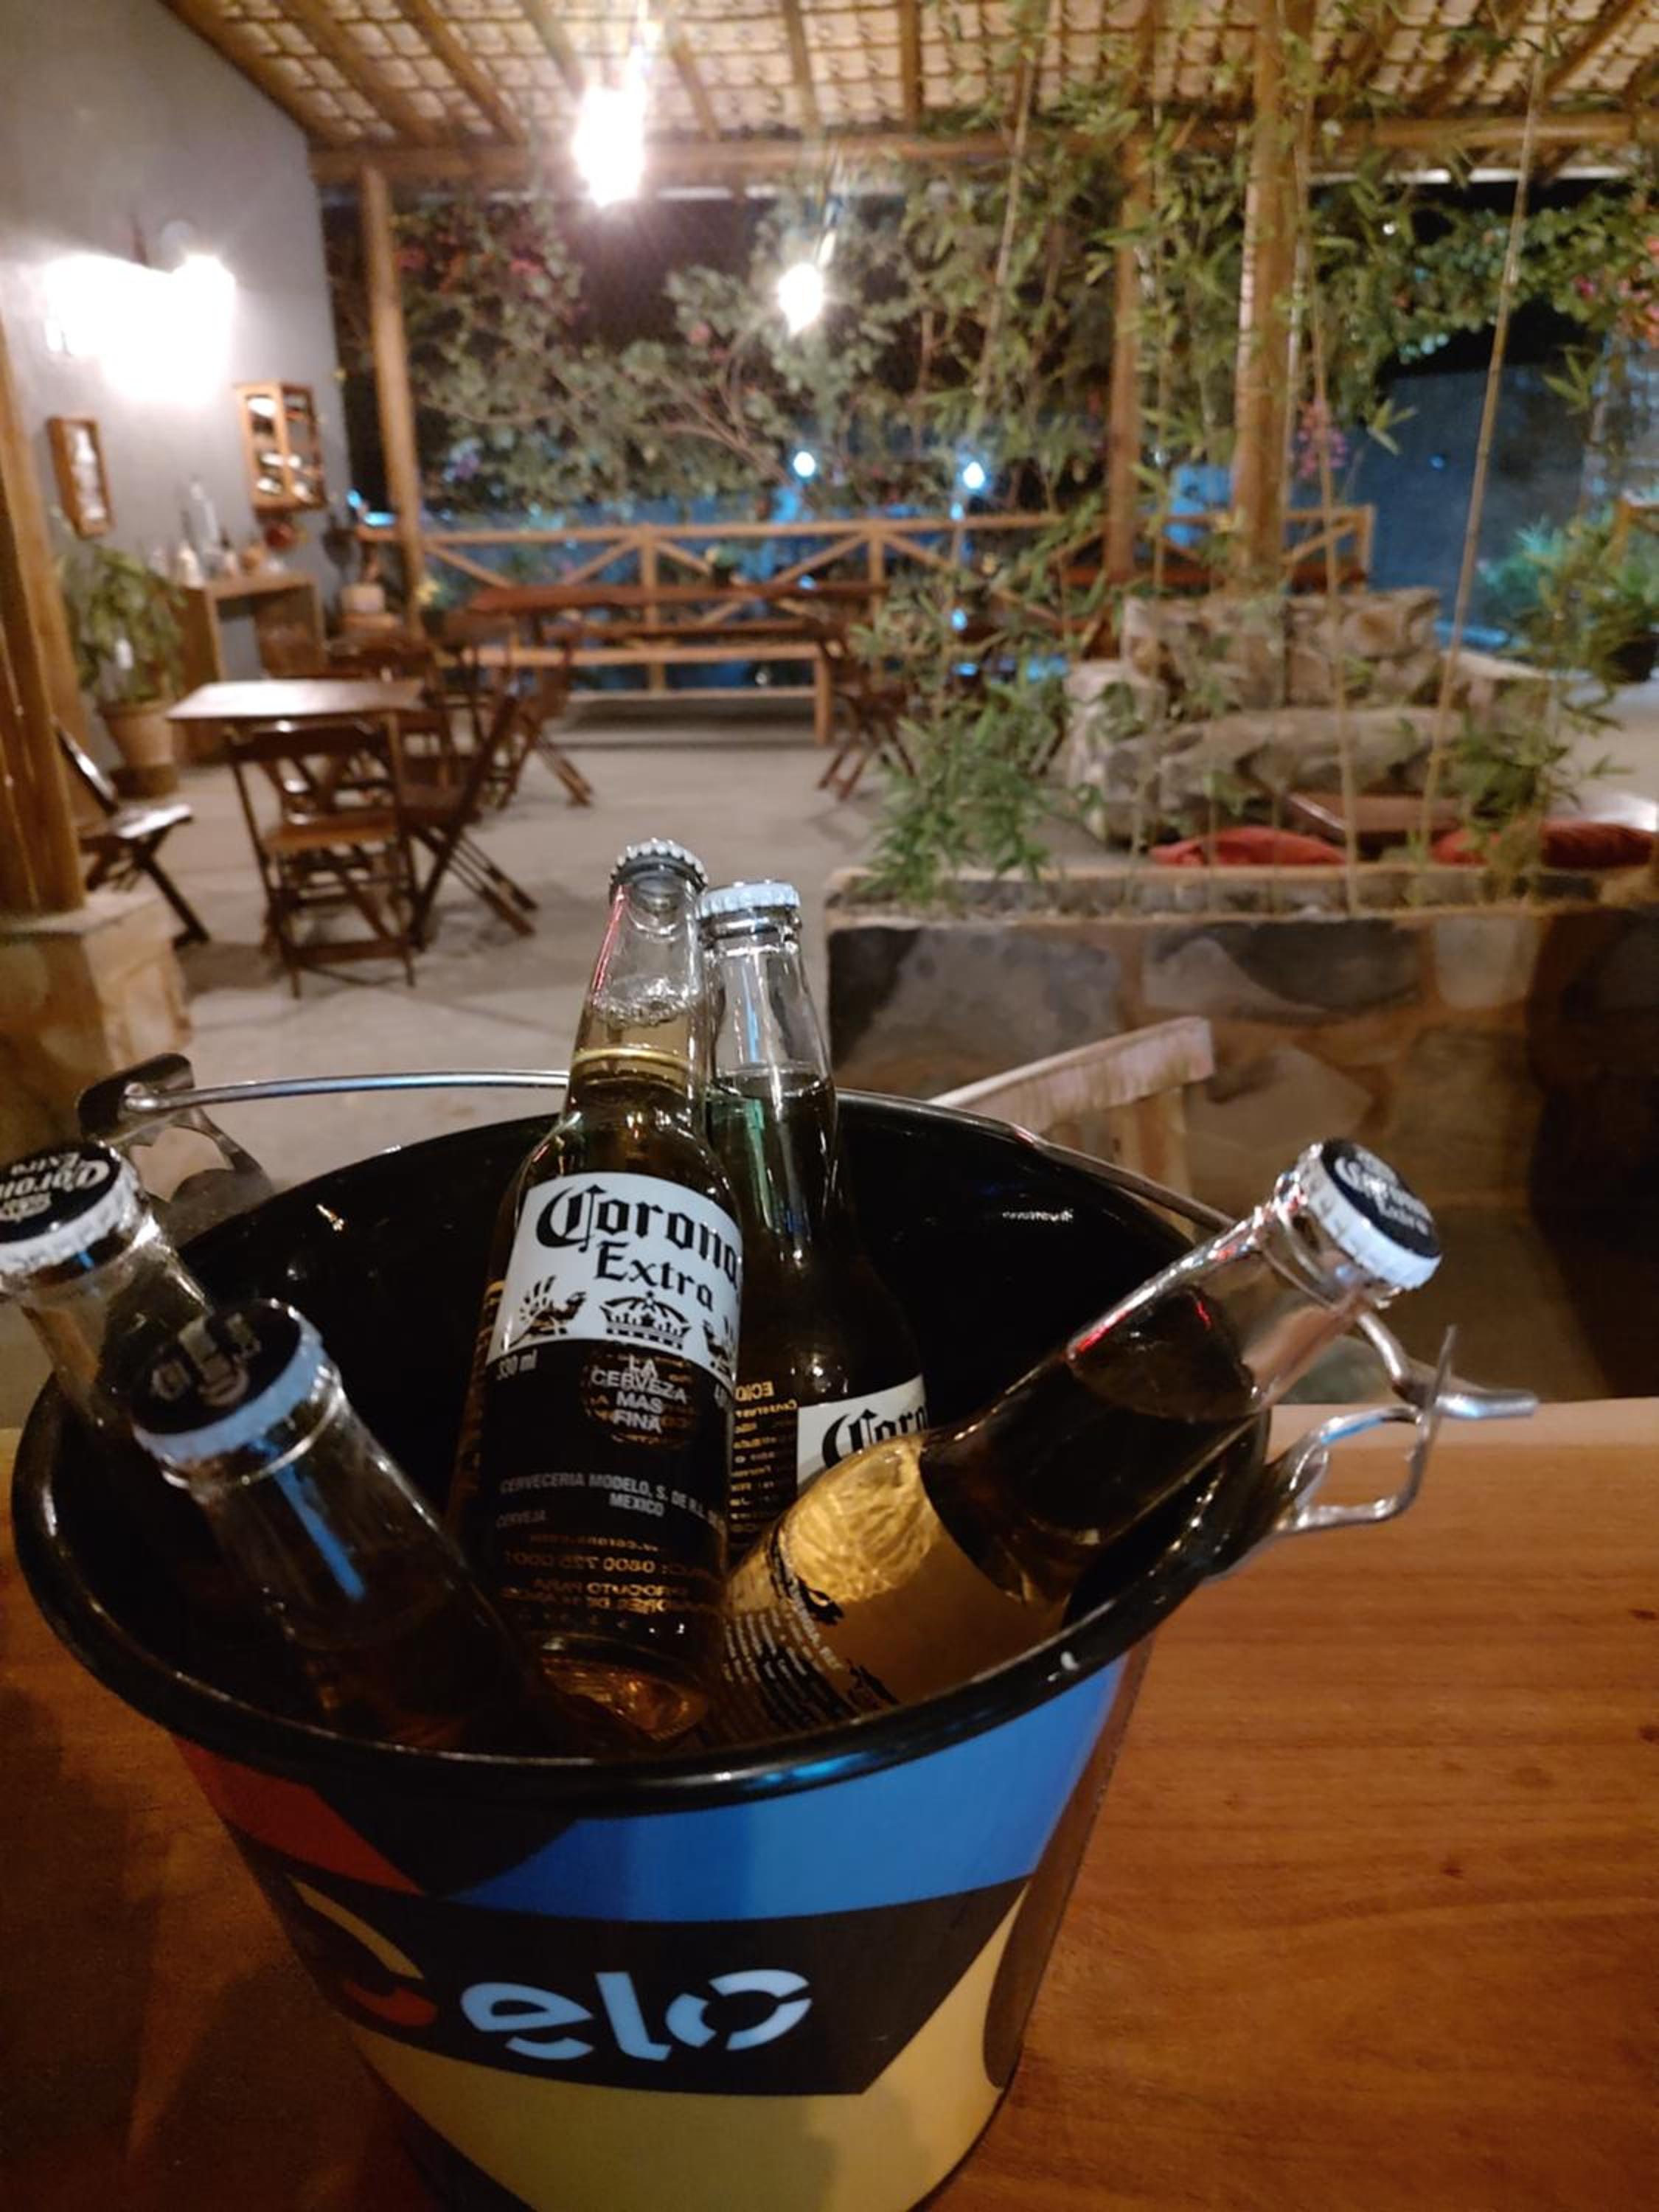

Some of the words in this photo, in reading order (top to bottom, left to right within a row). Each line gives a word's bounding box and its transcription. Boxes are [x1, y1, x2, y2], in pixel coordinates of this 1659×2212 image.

[535, 1184, 740, 1290] Corona
[594, 1240, 713, 1312] Extra
[591, 1369, 688, 1404] CERVEZA
[628, 1355, 658, 1378] LA
[612, 1409, 663, 1433] FINA
[460, 1969, 812, 2060] elo
